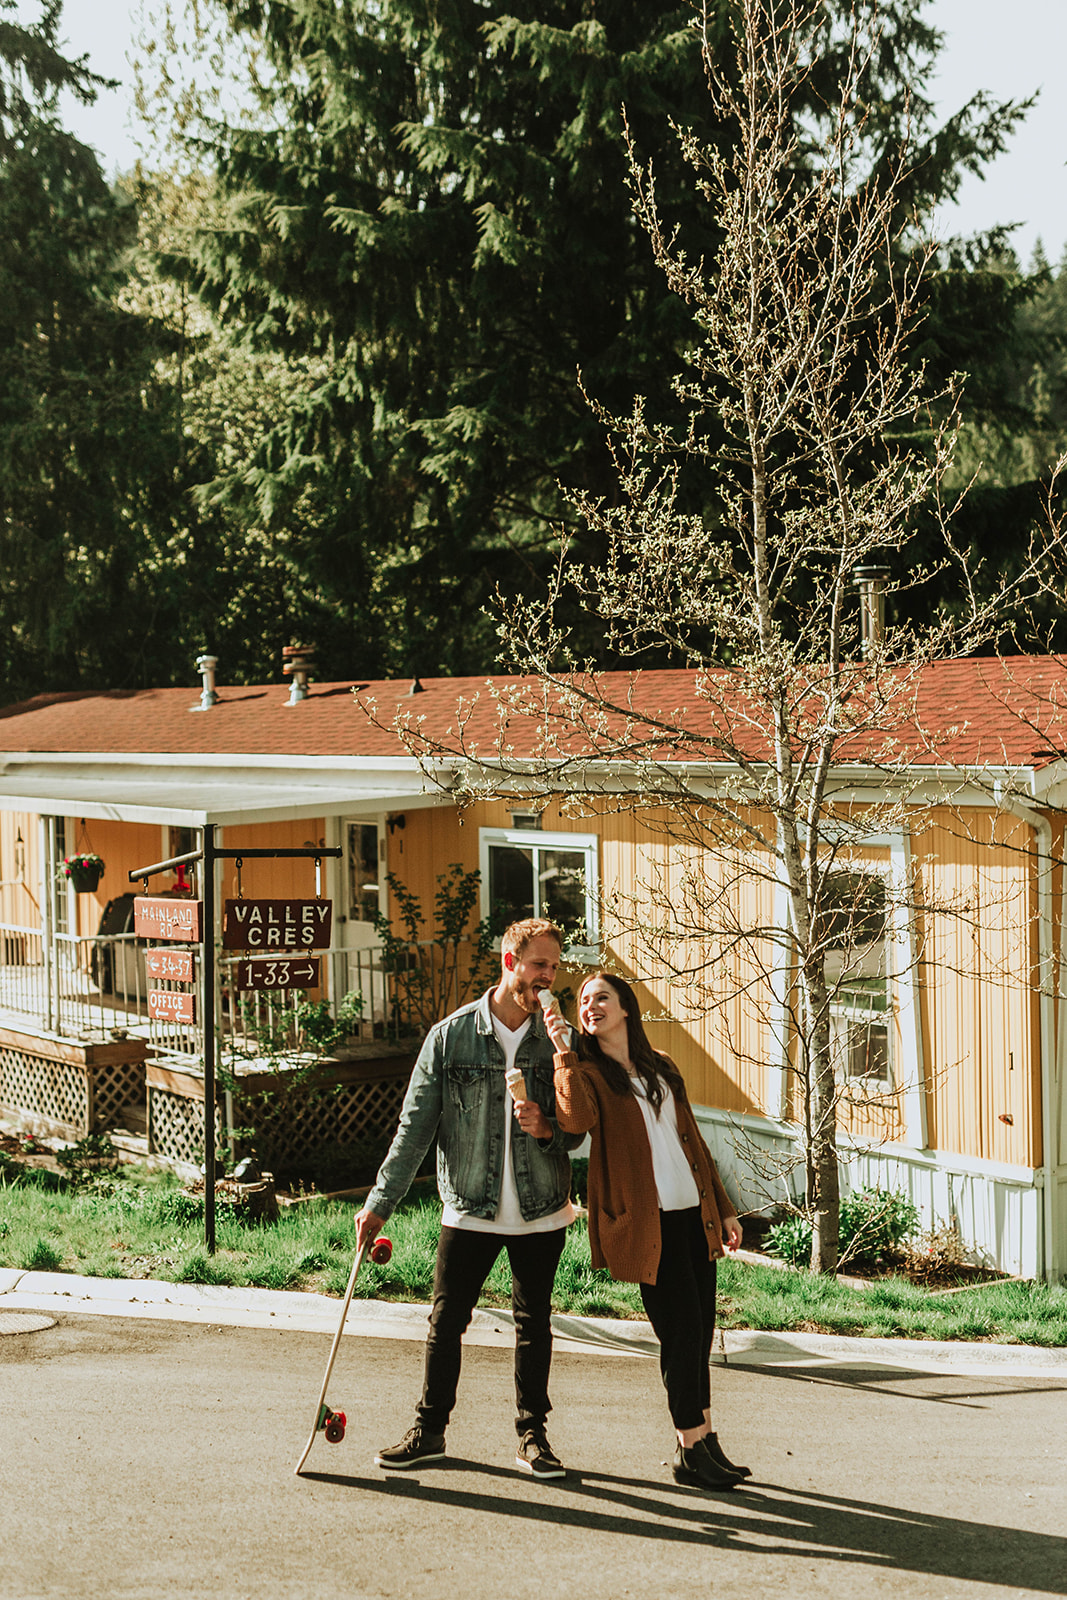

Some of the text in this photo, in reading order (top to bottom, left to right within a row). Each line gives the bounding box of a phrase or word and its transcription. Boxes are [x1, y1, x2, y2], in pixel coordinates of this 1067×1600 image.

[141, 906, 192, 923] MAINLAND
[234, 906, 328, 924] VALLEY
[248, 926, 315, 946] CRES
[245, 962, 290, 987] 1-33
[150, 993, 184, 1010] OFFICE
